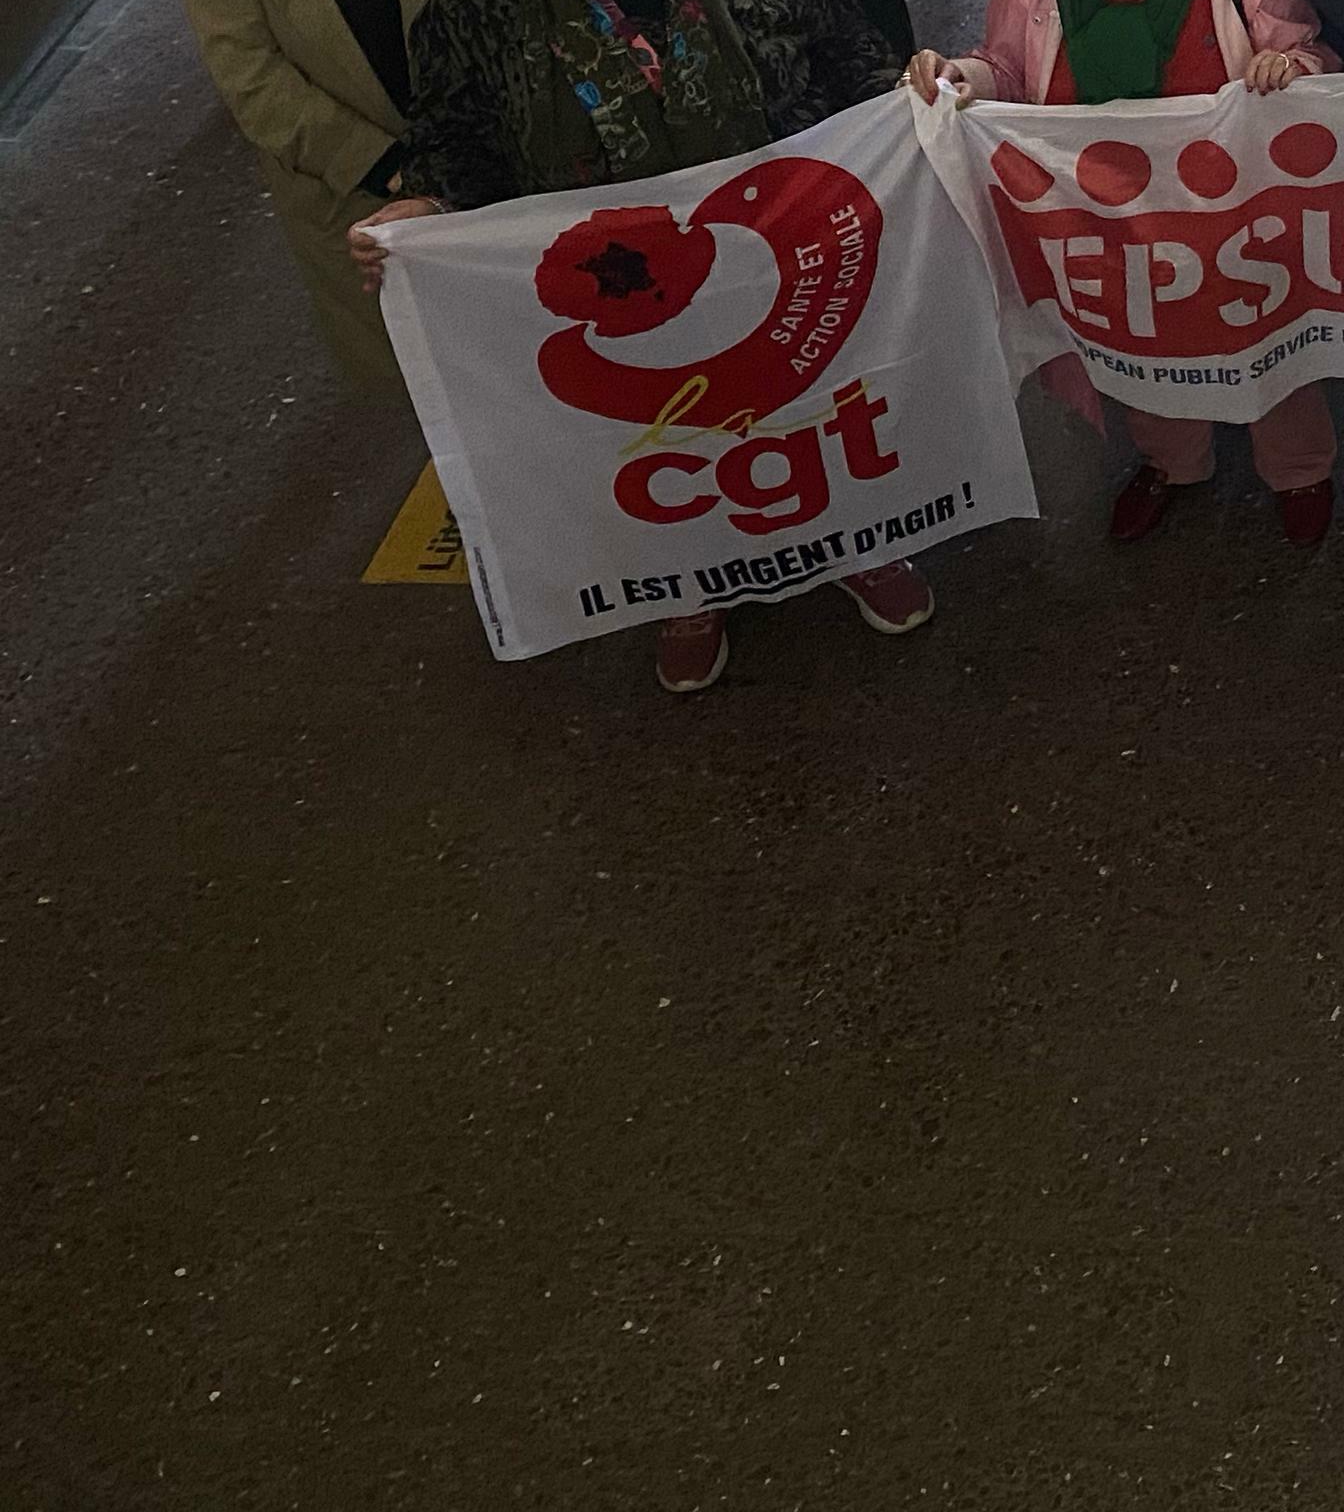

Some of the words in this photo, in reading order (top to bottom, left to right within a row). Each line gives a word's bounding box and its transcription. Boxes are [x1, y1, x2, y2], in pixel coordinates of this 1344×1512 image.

[789, 296, 850, 376] ACTION
[829, 203, 865, 290] SOCIALE
[794, 242, 825, 271] ET
[769, 274, 823, 345] SANTÉ
[1153, 366, 1242, 387] PUBLIC
[1249, 325, 1334, 378] SERVICE
[613, 378, 900, 536] cgt
[579, 584, 615, 617] IL
[625, 574, 685, 606] EST
[694, 530, 845, 595] URGENT
[854, 492, 956, 555] D'AGIR
